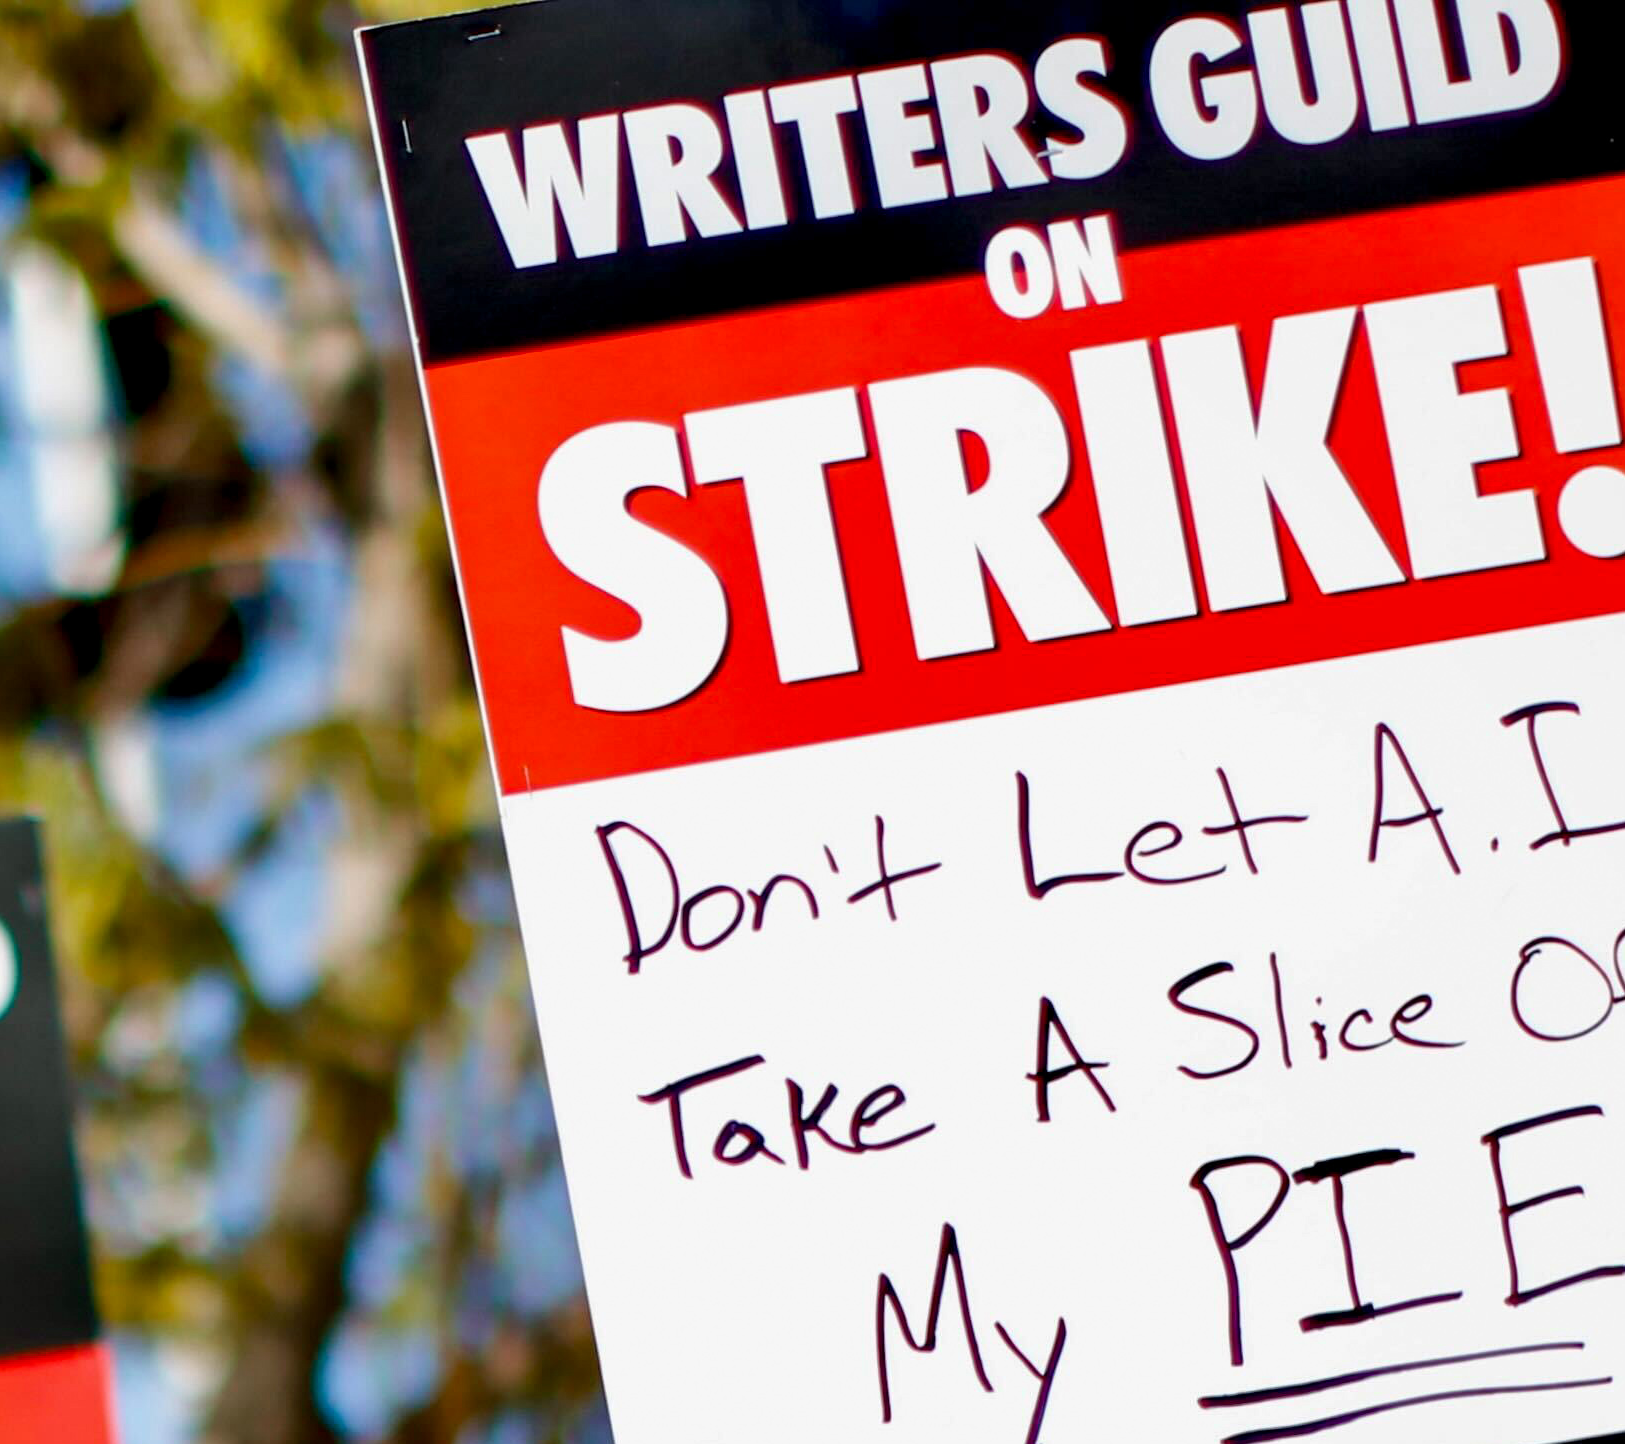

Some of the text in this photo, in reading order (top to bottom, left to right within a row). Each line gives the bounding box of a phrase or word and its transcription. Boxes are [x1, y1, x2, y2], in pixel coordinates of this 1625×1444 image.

[465, 0, 1562, 270] WRITERS GUILD
[984, 216, 1123, 319] ON
[596, 815, 941, 974] Don't
[1016, 767, 1307, 897] Let
[638, 1055, 936, 1178] Take
[1024, 995, 1115, 1122] A
[1168, 952, 1466, 1079] Slice
